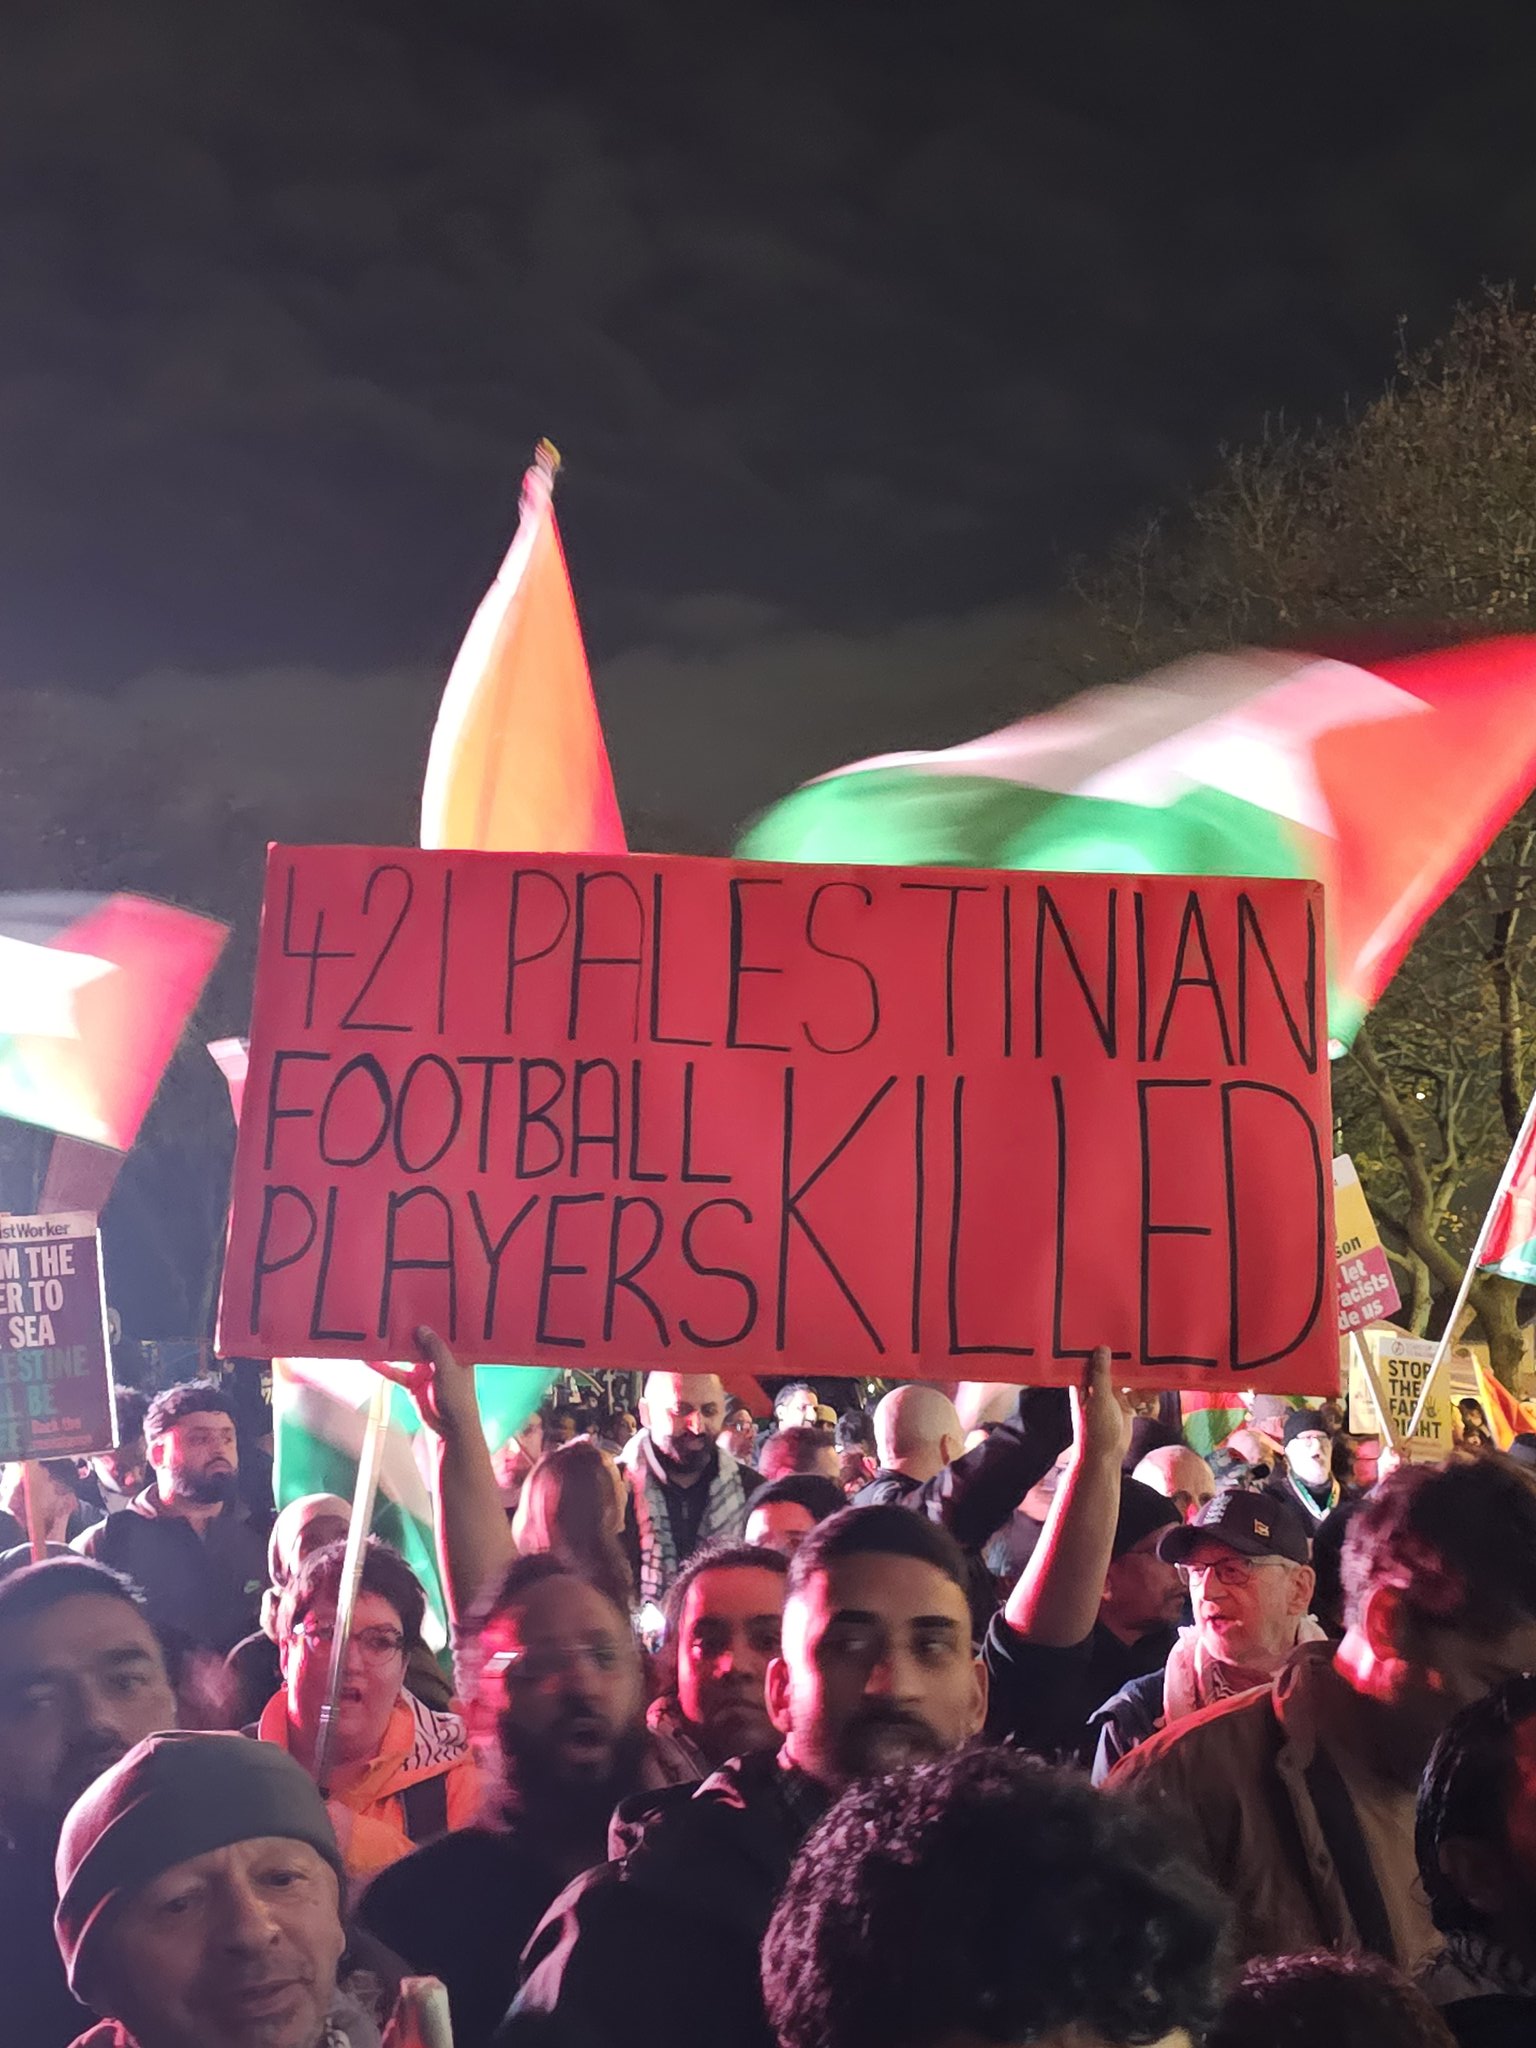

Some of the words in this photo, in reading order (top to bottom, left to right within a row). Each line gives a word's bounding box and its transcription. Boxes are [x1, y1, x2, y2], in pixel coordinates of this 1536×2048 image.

[283, 864, 453, 1035] 421
[504, 868, 1317, 1074] PALESTINIAN
[263, 1050, 732, 1184] FOOTBALL
[775, 1066, 1326, 1372] KILLED
[25, 1244, 76, 1279] THE
[250, 1184, 759, 1348] PLAYERS
[1340, 1259, 1368, 1284] let
[28, 1279, 64, 1313] TO
[1338, 1272, 1390, 1308] acists
[1361, 1299, 1384, 1320] us
[8, 1314, 56, 1349] SEA
[1388, 1378, 1422, 1398] THE
